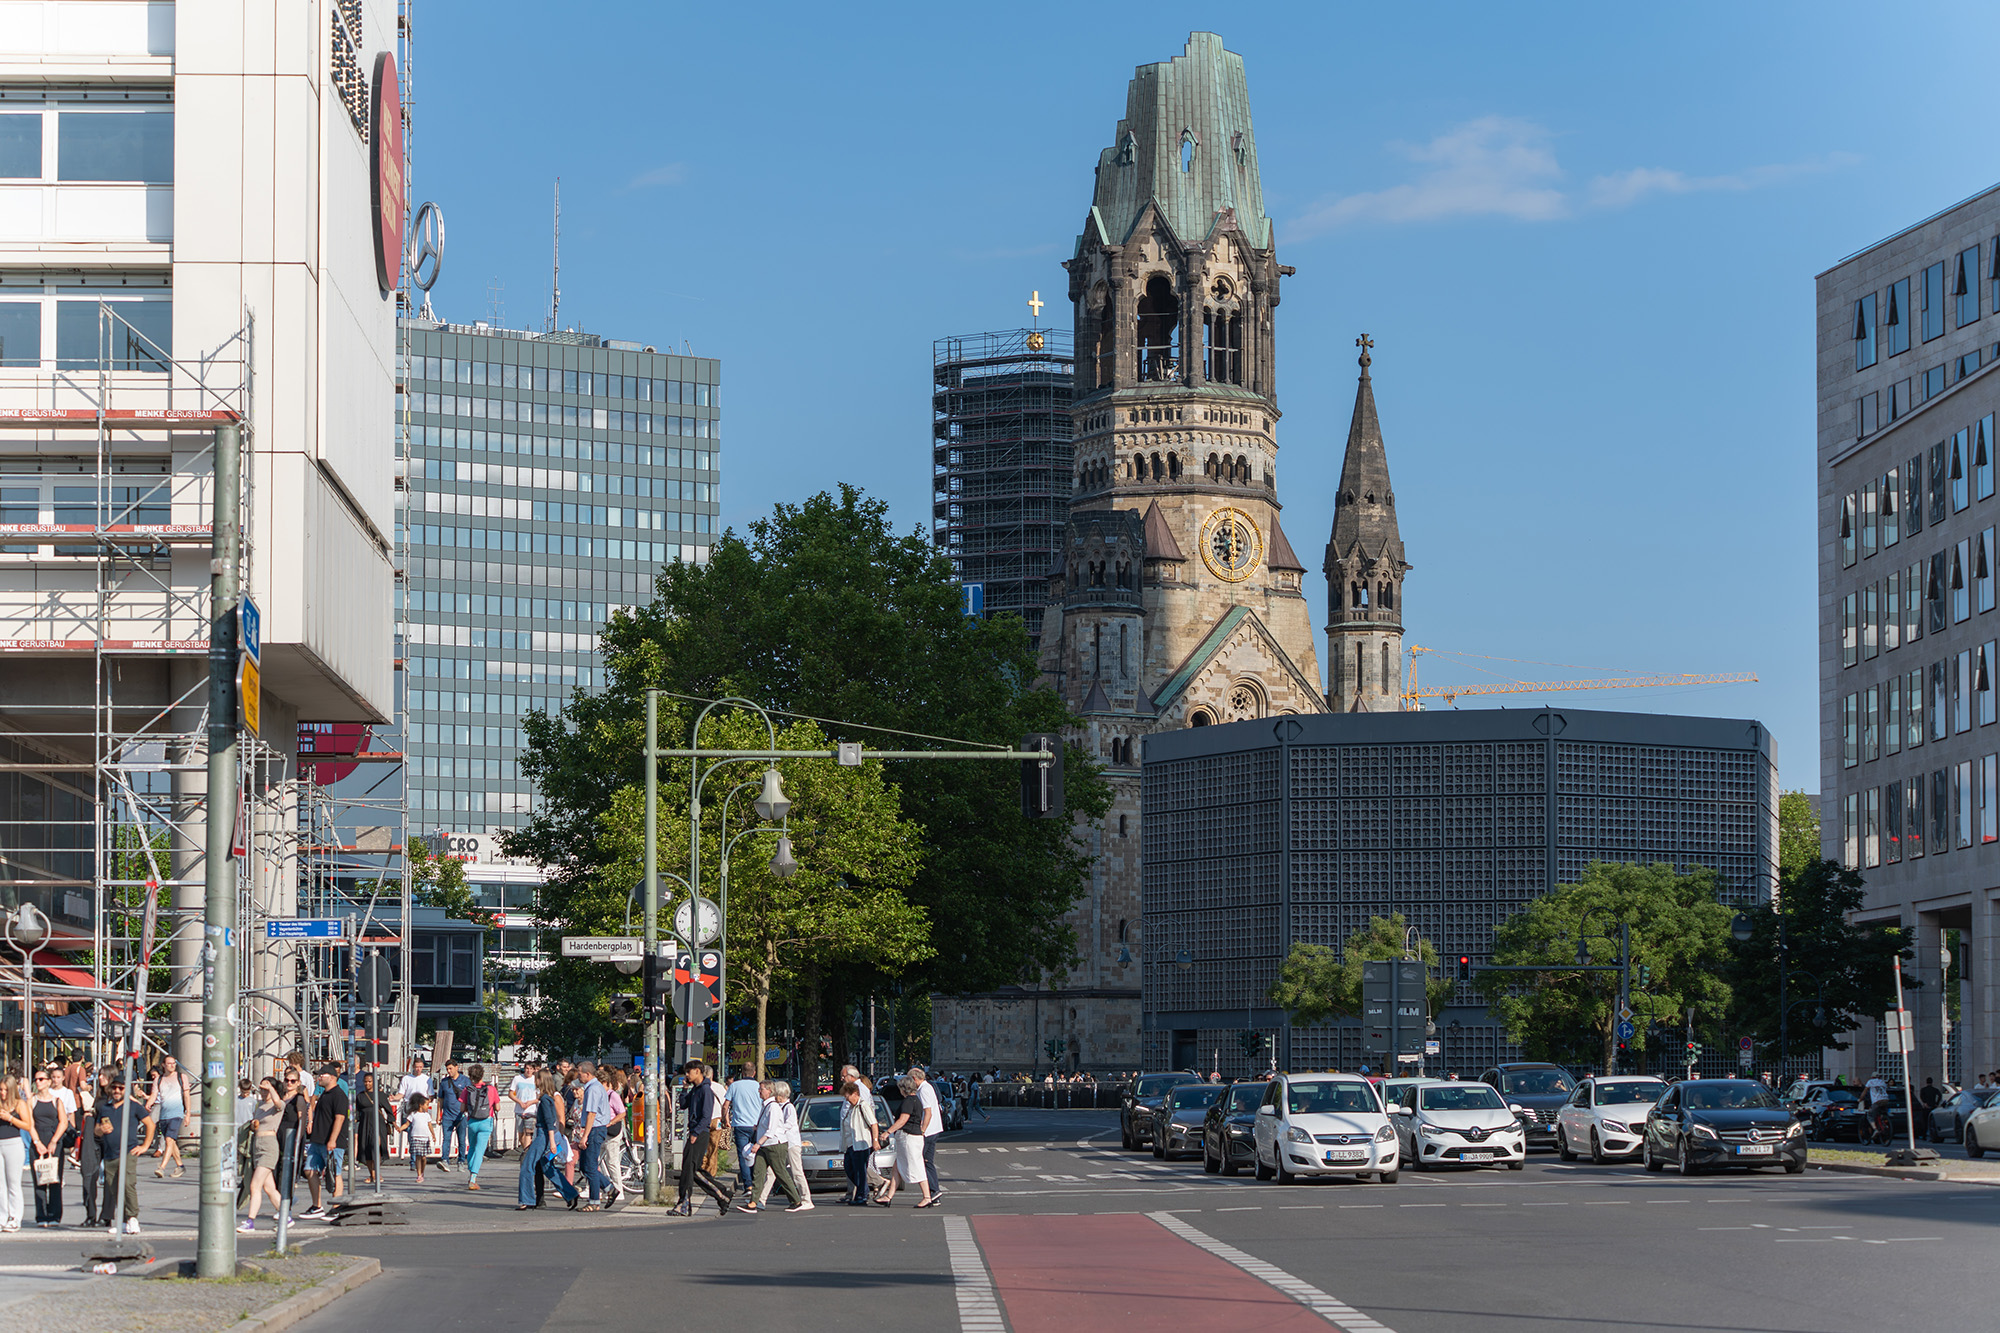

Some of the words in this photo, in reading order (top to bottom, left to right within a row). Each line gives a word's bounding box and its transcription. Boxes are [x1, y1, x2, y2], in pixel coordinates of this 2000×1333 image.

[134, 410, 165, 418] MENKE
[133, 525, 164, 533] MENKE
[132, 641, 163, 649] MENKE
[569, 941, 633, 952] Hardenbergplatz
